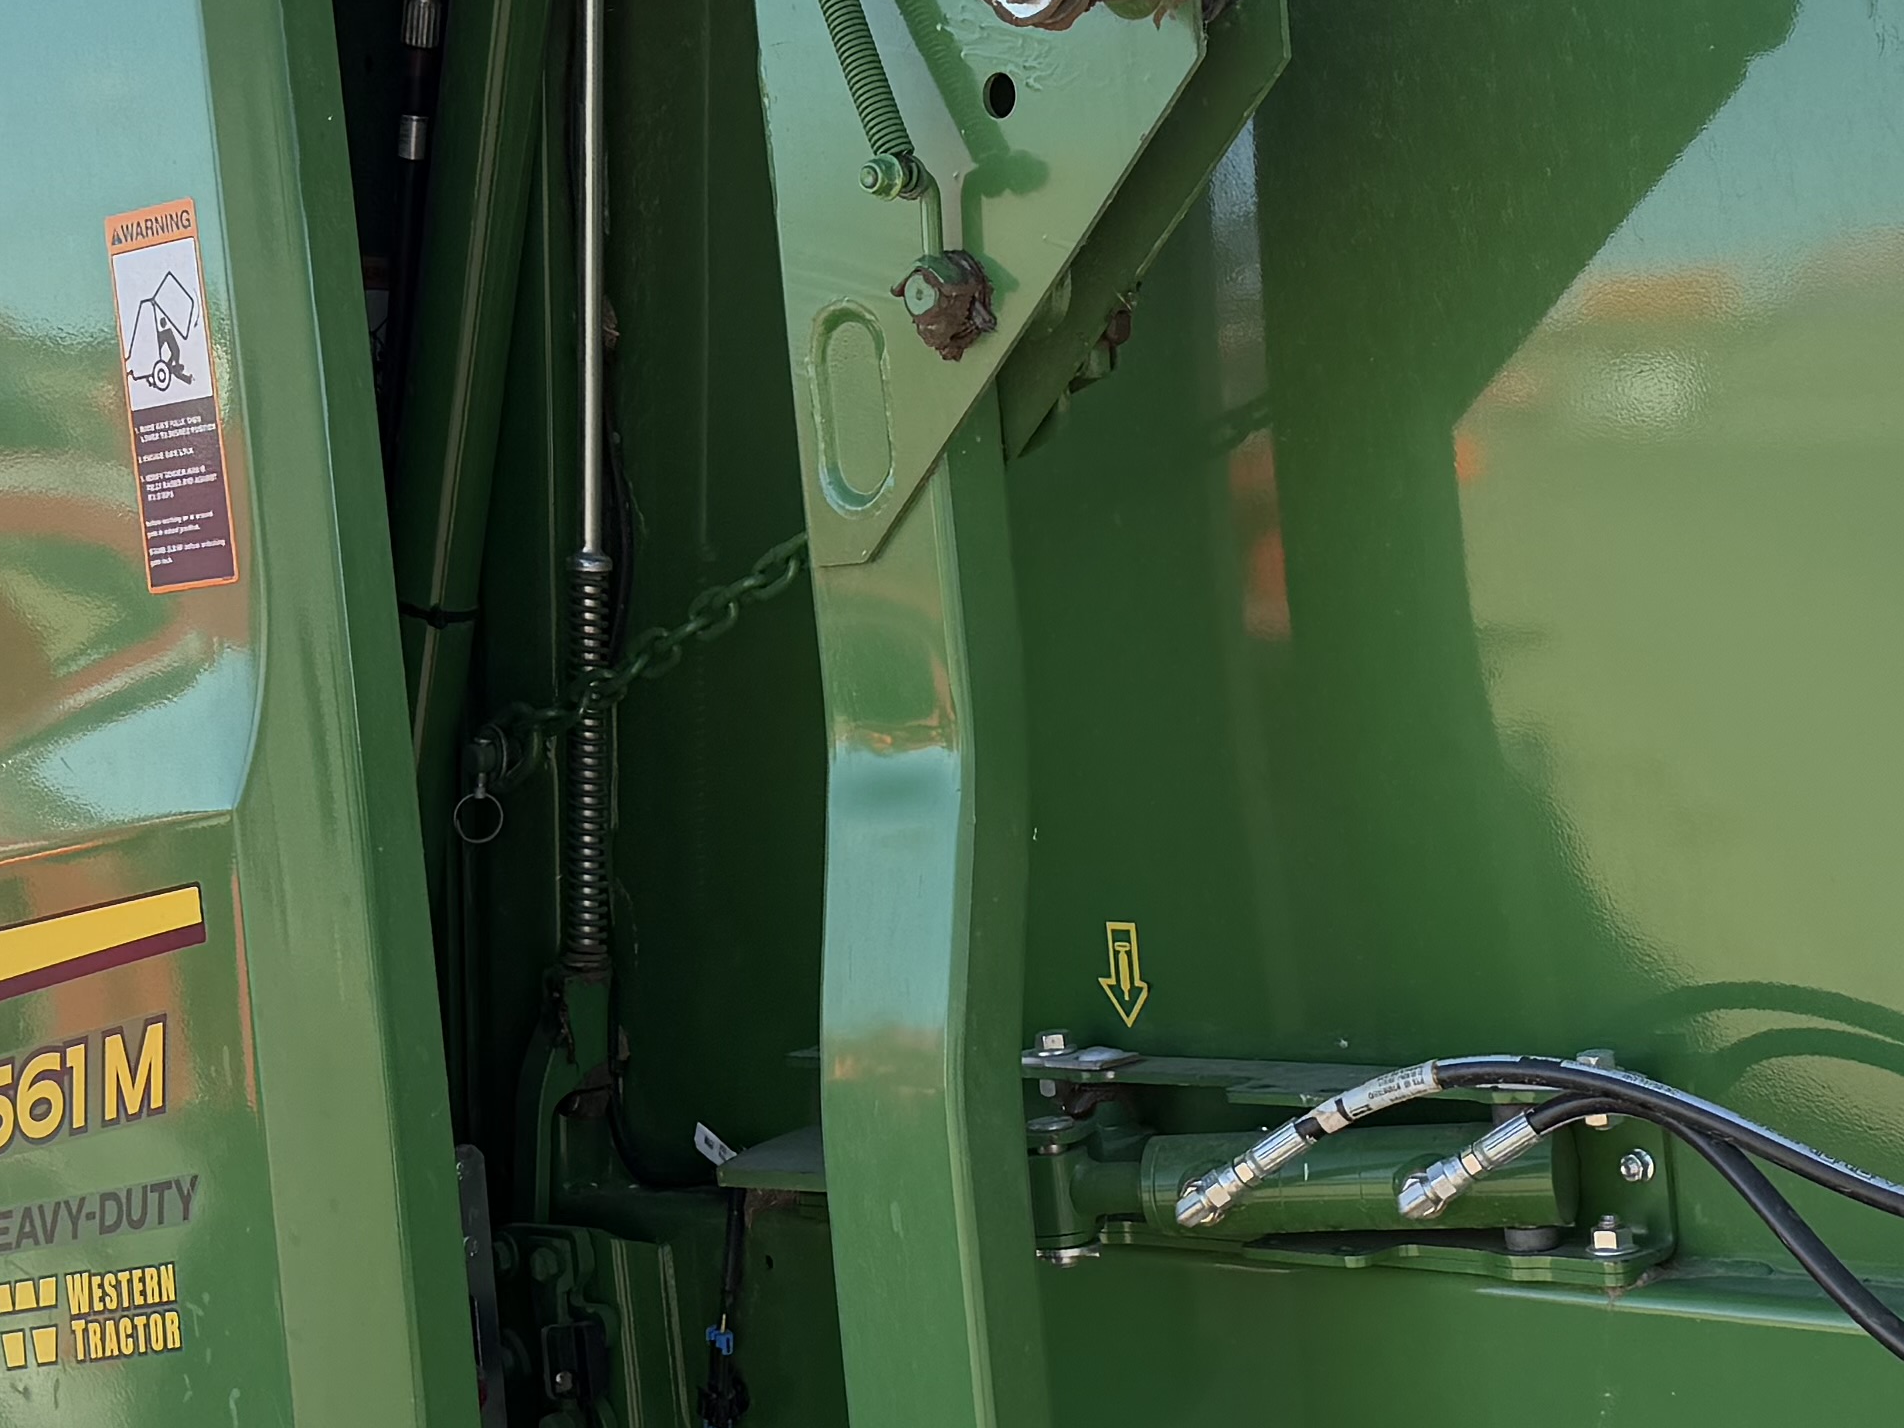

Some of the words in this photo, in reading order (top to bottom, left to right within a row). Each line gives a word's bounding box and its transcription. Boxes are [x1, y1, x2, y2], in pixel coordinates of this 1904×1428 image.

[120, 209, 192, 243] WARNING
[102, 1017, 166, 1125] M
[65, 1262, 177, 1317] WESTERN
[70, 1310, 182, 1363] TRACTOR
